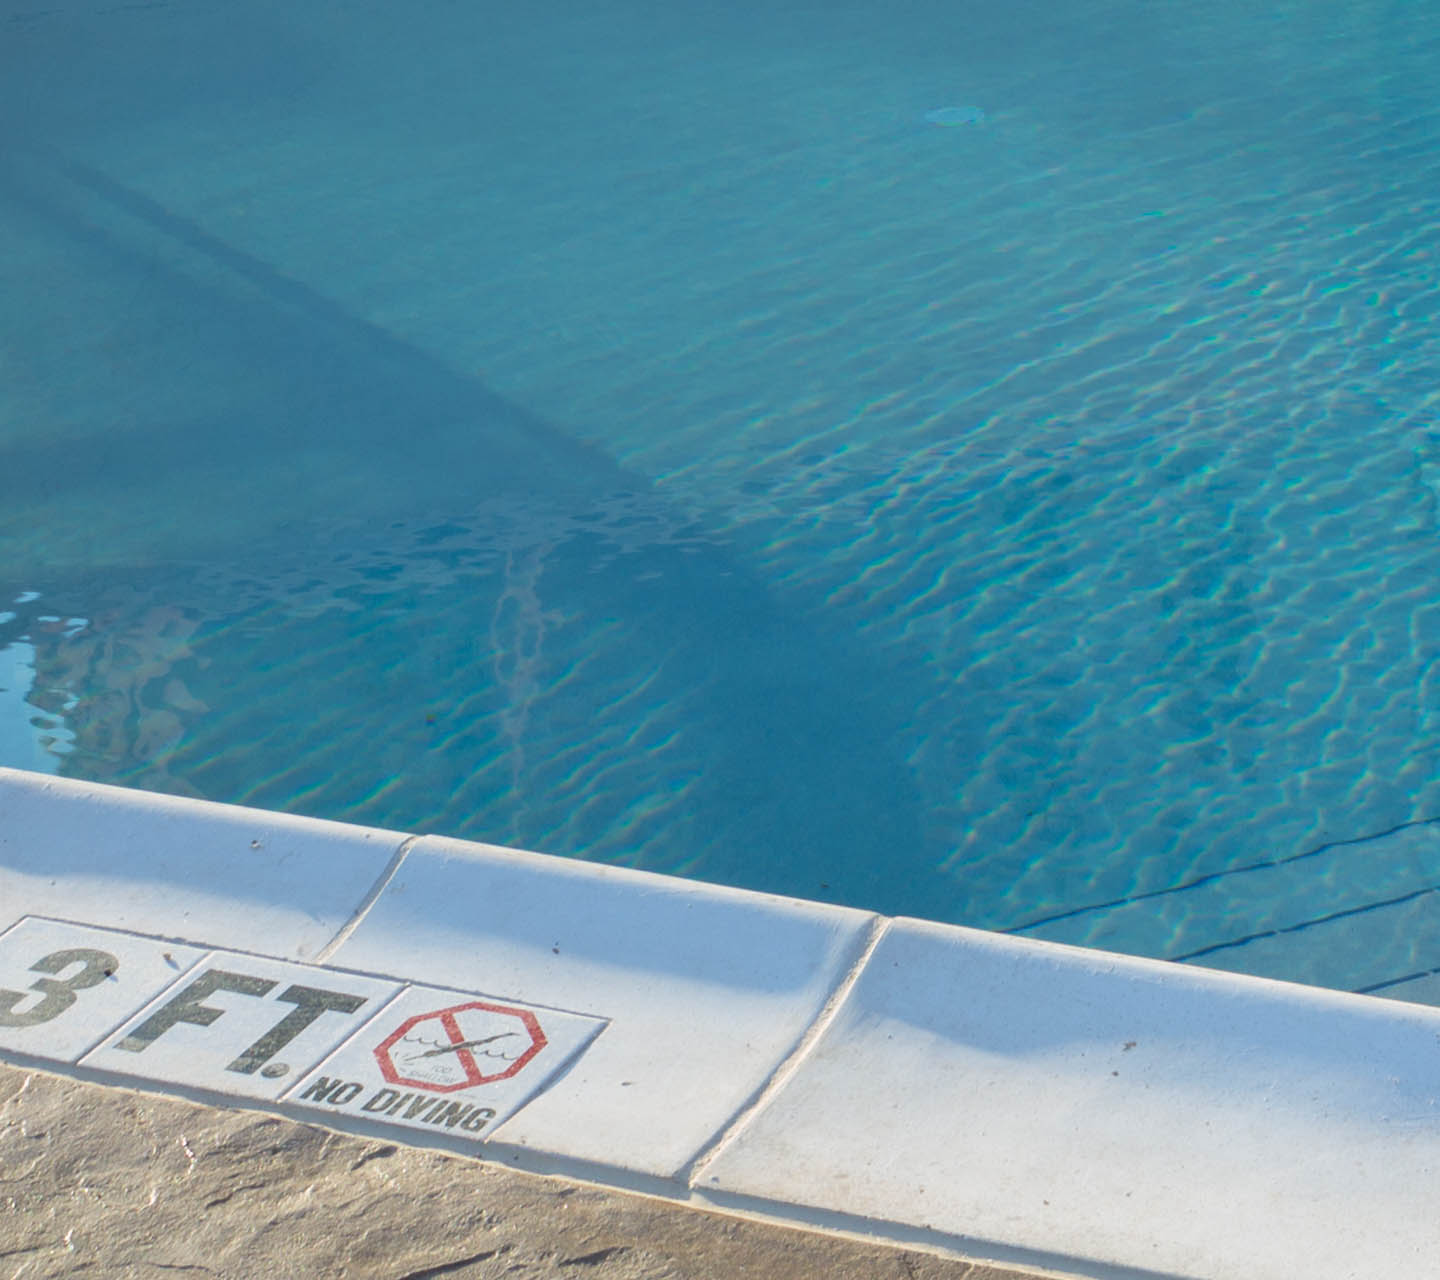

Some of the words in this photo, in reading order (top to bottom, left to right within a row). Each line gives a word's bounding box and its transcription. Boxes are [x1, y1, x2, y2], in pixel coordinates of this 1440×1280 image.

[114, 969, 366, 1080] FT.
[300, 1076, 364, 1105] NO
[361, 1088, 497, 1133] DIVING
